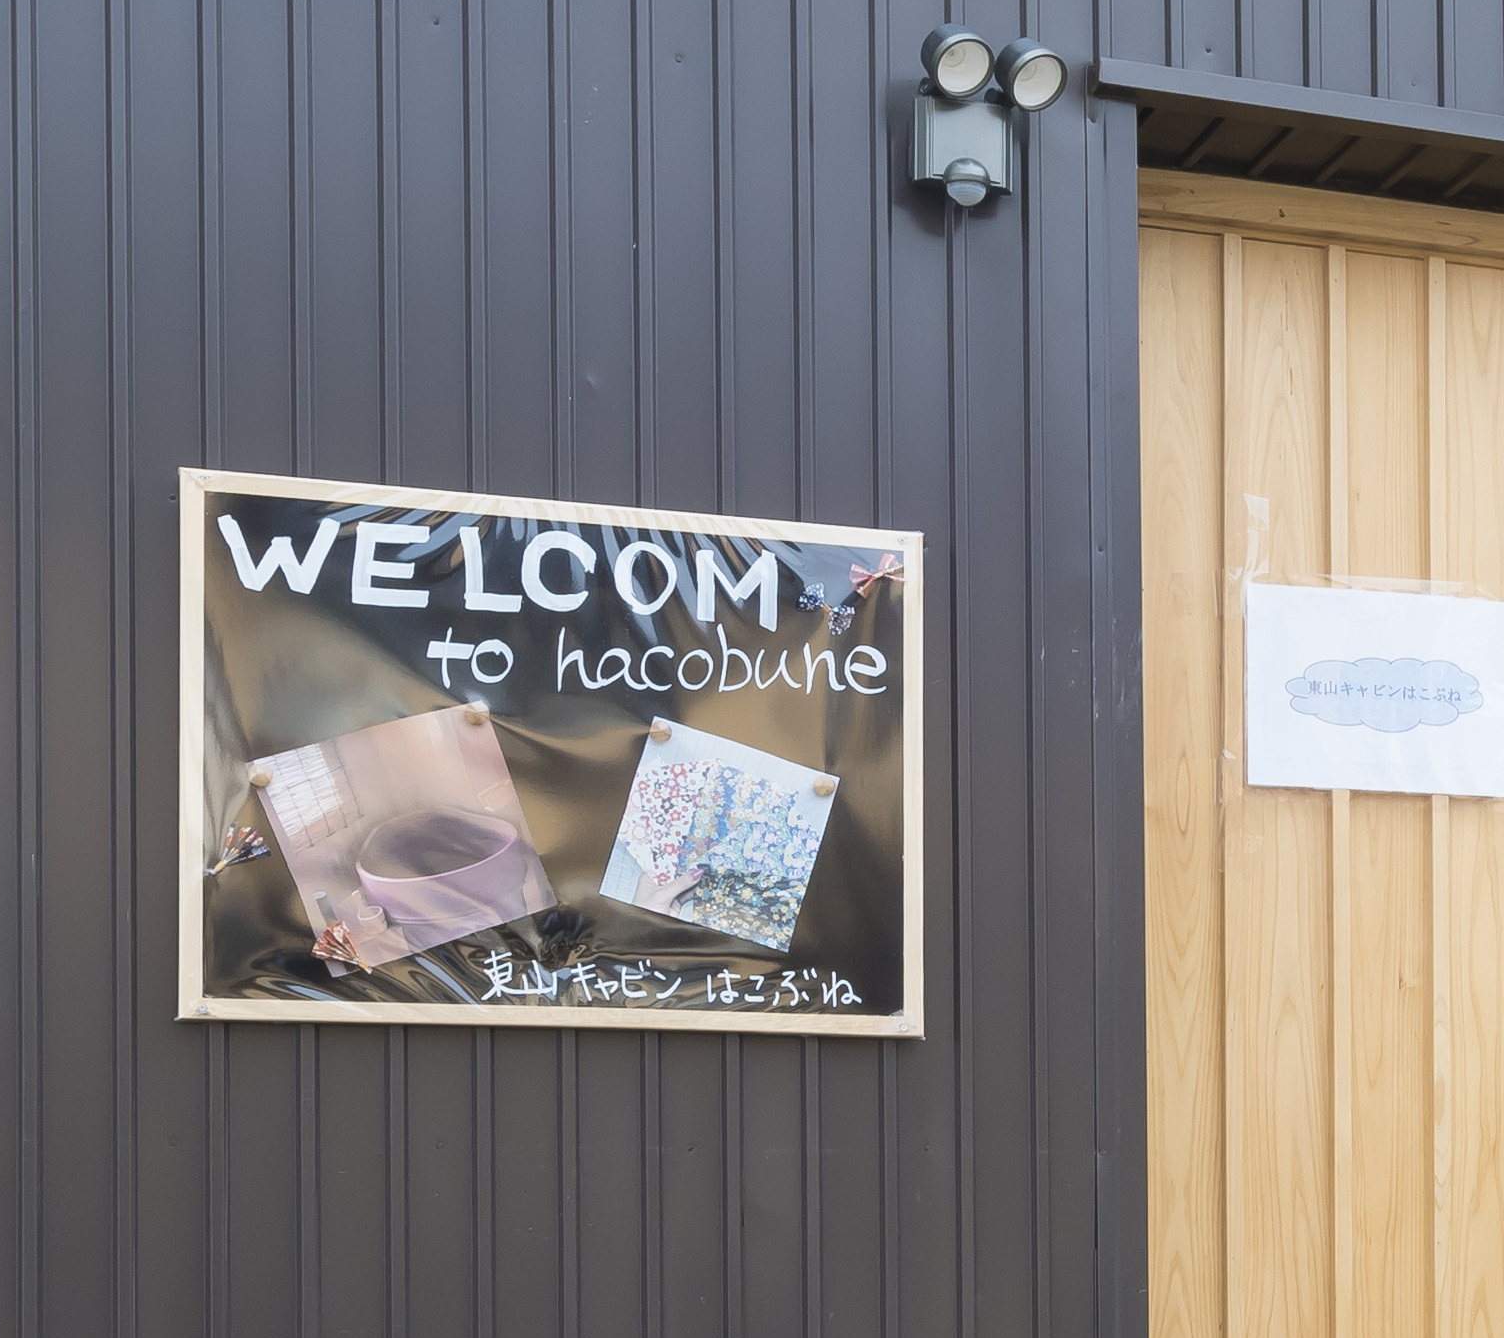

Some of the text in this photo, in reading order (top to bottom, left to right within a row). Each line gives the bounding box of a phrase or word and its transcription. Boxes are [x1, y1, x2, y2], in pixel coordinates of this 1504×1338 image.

[217, 513, 780, 632] WELCOM
[426, 625, 889, 696] to hacobune
[1307, 679, 1462, 703] 東山キャビンはこぶね
[480, 949, 863, 1008] 東山キャビン はこぶね
